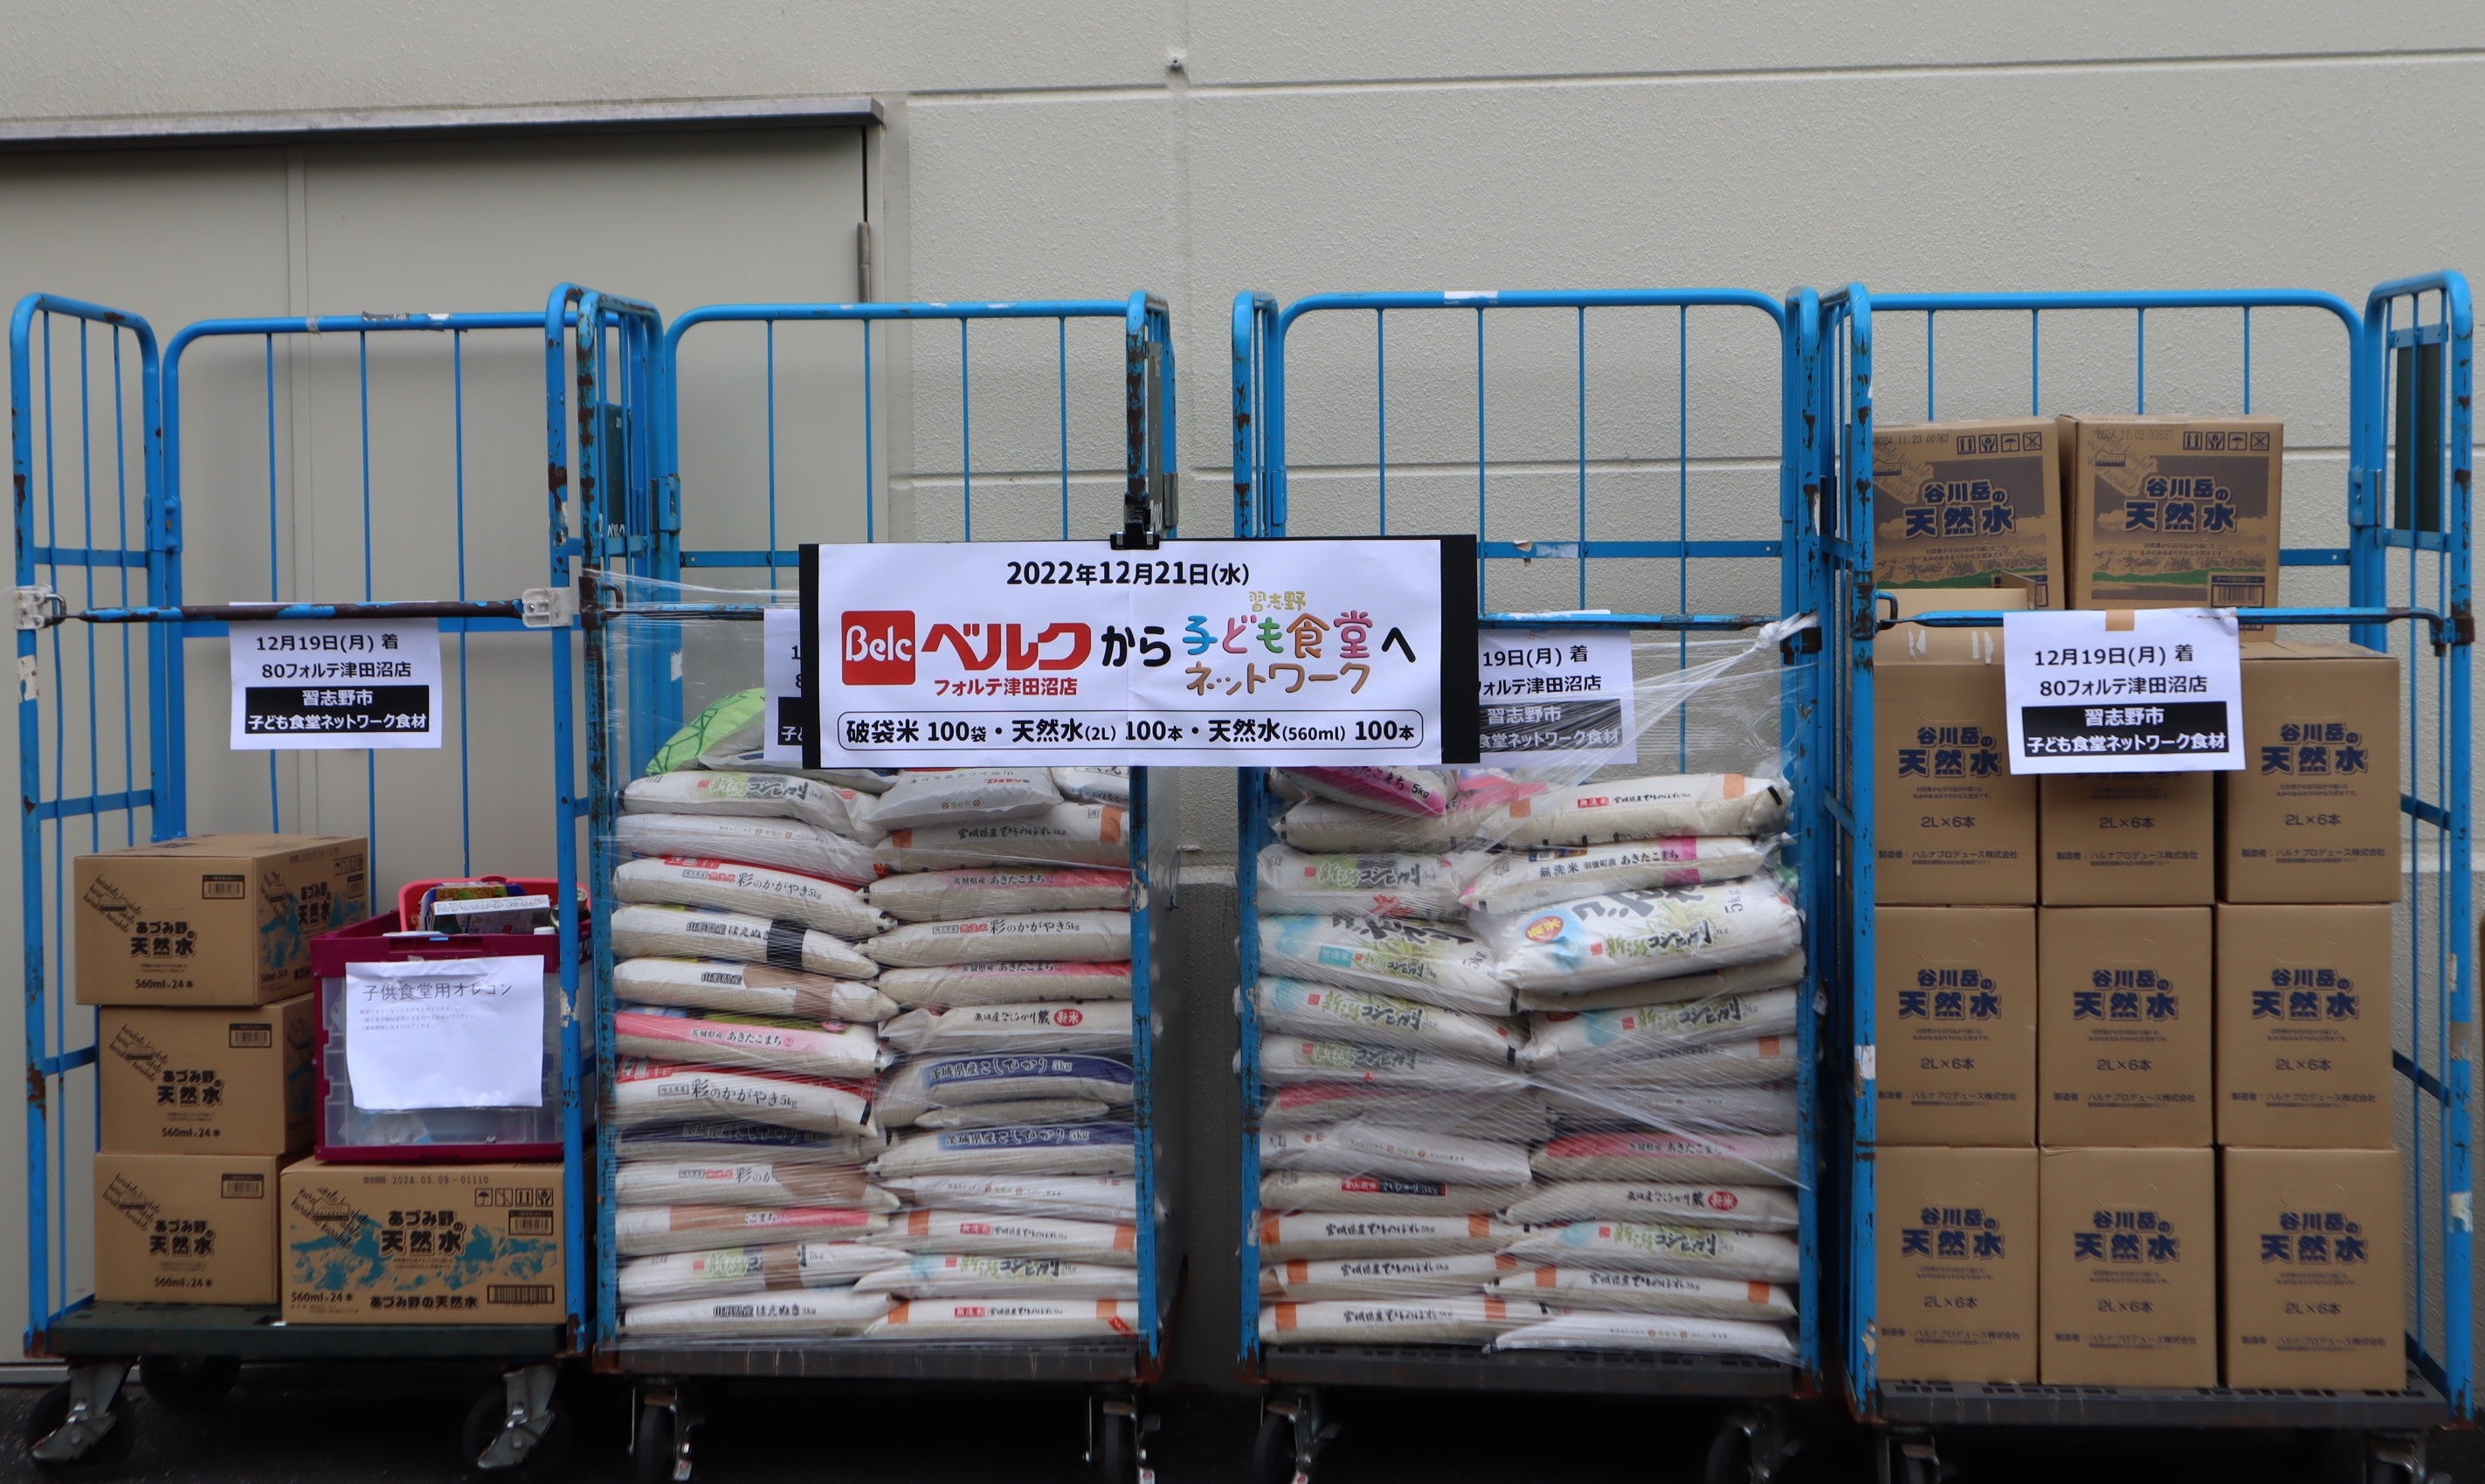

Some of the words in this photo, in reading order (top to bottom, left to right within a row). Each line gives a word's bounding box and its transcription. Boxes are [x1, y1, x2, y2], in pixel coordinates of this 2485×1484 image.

[1923, 481, 2006, 504] 谷川岳の
[2146, 478, 2229, 500] 谷川岳の
[1904, 505, 2013, 536] 天然水
[2125, 500, 2234, 531] 天然水
[1007, 561, 1249, 586] 2022年12月21日(水)
[1249, 590, 1306, 611] 習志野
[256, 635, 374, 652] 12月19日(月)
[381, 633, 398, 650] 着
[846, 625, 913, 662] Belc
[1183, 611, 1373, 659] 子ども食堂
[1381, 626, 1417, 663] へ
[921, 622, 1092, 671] ベルク
[1101, 625, 1172, 667] から
[1570, 645, 1588, 663] 着
[2034, 646, 2166, 666] 12月19日(月)
[2175, 645, 2194, 662] 着
[262, 662, 411, 678] 80フォルテ津田沼店
[1184, 660, 1371, 696] ネットワーク
[935, 678, 1078, 697] フォルテ津田沼店
[2040, 676, 2208, 696] 80フォルテ津田沼店
[302, 689, 374, 706] 習志野市
[248, 714, 427, 730] 子ども食堂ネットワーク食材
[1488, 706, 1562, 725] 習志野市
[2085, 707, 2165, 727] 習志野市
[846, 719, 920, 743] 破袋米
[928, 718, 1116, 743] 100袋・天然水(2L)
[1125, 718, 1345, 743] 100本・天然水(560ml)
[1354, 720, 1415, 742] 100本
[1916, 727, 1994, 748] 谷川岳の
[2280, 723, 2359, 744] 谷川岳の
[2026, 732, 2226, 753] 子ども食堂ネットワーク食材
[1898, 749, 1999, 776] 天然水
[2261, 746, 2364, 773] 天然水
[1411, 783, 1430, 799] 5kg
[1578, 797, 1609, 808] 無洗米
[1922, 816, 1977, 829] 2L×6本
[2100, 816, 2155, 829] 2L×6本
[2285, 813, 2342, 826] 2L×6本
[1540, 862, 1579, 878] 無洗米
[1621, 848, 1679, 866] あきたこまち
[990, 874, 1046, 885] あきたこまち
[135, 920, 195, 940] あづみ野の
[130, 936, 195, 956] 天然水
[1916, 969, 1995, 990] 谷川岳の
[2092, 970, 2171, 991] 谷川岳の
[2271, 969, 2351, 990] 谷川岳の
[1898, 990, 1999, 1018] 天然水
[2073, 991, 2176, 1019] 天然水
[2252, 990, 2357, 1018] 天然水
[727, 1031, 783, 1046] あきたこまち
[1052, 1060, 1073, 1073] 5kg
[156, 1086, 221, 1105] 天然水
[1069, 1129, 1090, 1141] 5kg
[388, 1210, 463, 1232] あづみ野の
[149, 1235, 212, 1254] 天然水
[381, 1229, 464, 1253] 天然水
[1902, 1229, 2003, 1257] 天然水
[2074, 1232, 2178, 1261] 天然水
[2260, 1234, 2366, 1262] 天然水
[370, 1294, 479, 1308] あづみ野の天然水
